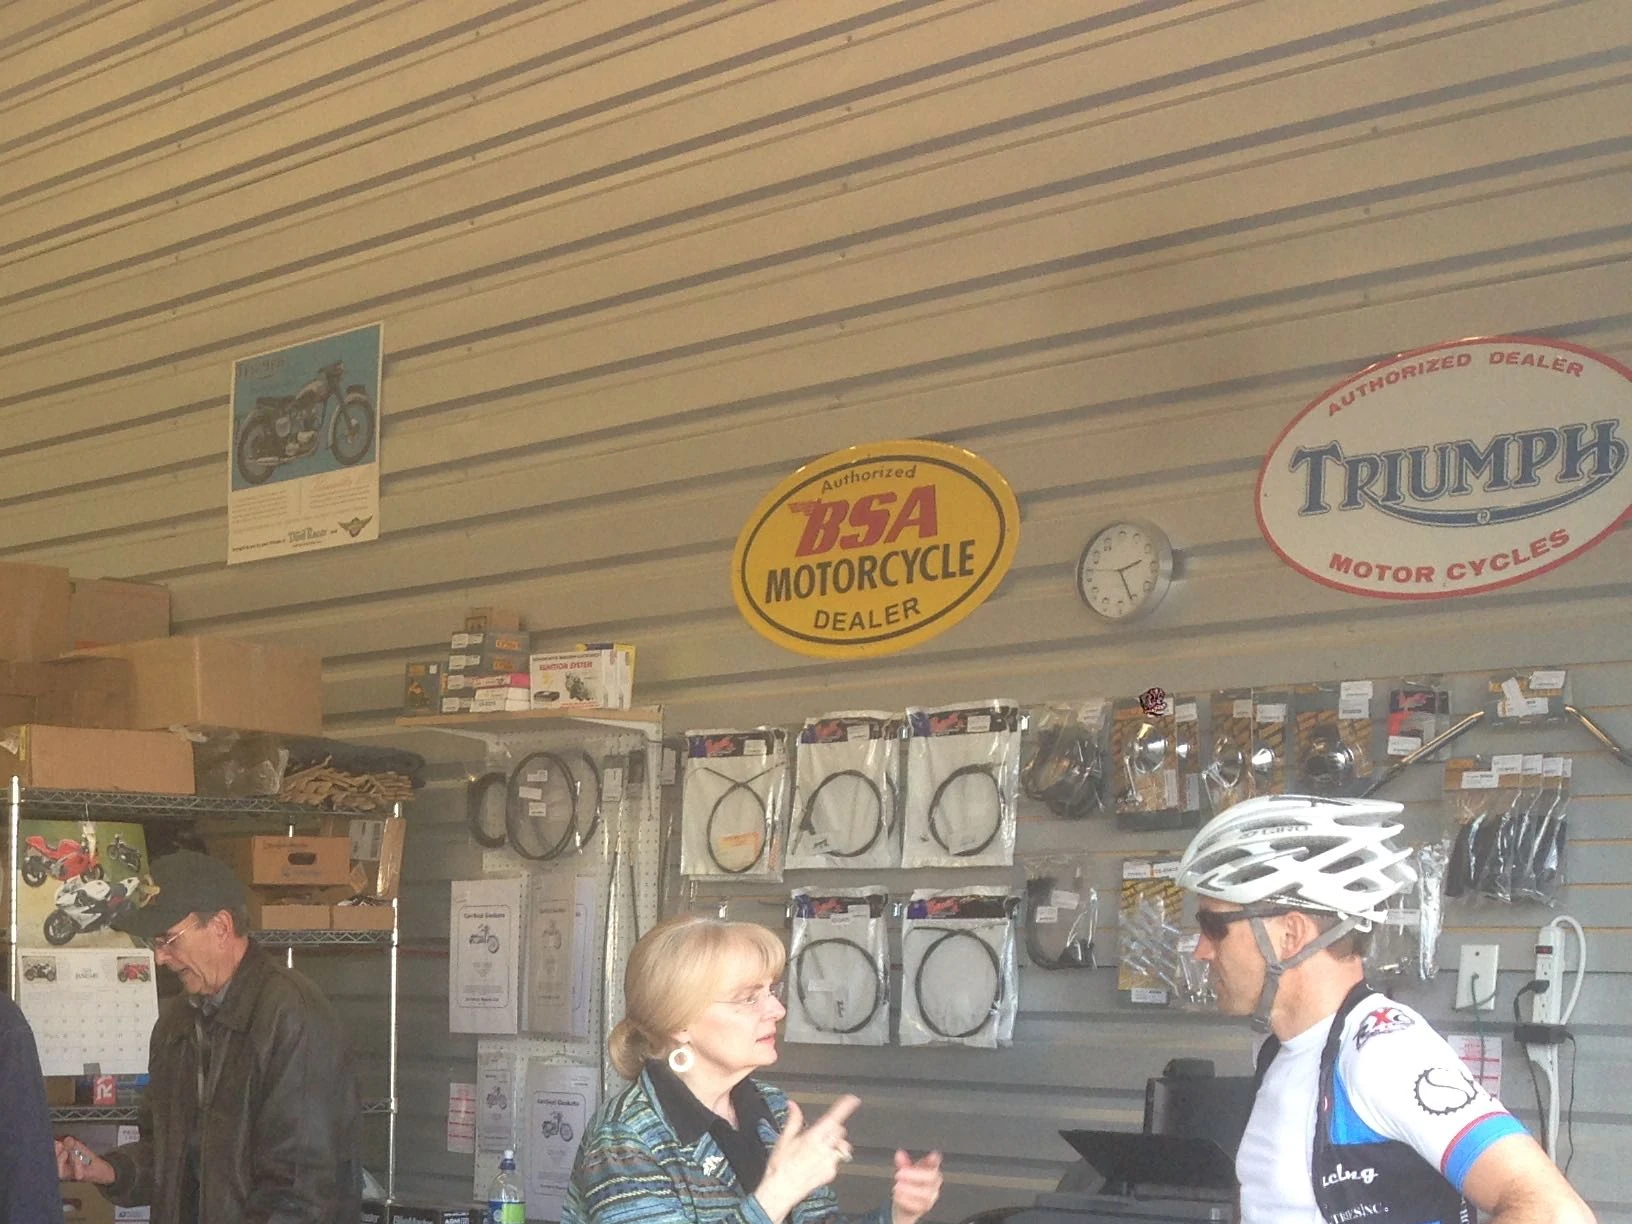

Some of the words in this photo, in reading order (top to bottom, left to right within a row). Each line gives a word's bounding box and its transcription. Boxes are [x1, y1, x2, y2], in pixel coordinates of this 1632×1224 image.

[1328, 352, 1472, 417] AUTHORIZED
[1489, 350, 1585, 379] DEALER
[821, 464, 917, 495] Authorized
[1289, 418, 1630, 520] TRIUMPH
[787, 484, 939, 558] BSA
[764, 540, 977, 604] MOTORCYCLE
[1328, 552, 1436, 583] MOTOR
[1446, 527, 1572, 582] CYCLES
[814, 597, 921, 632] DEALER
